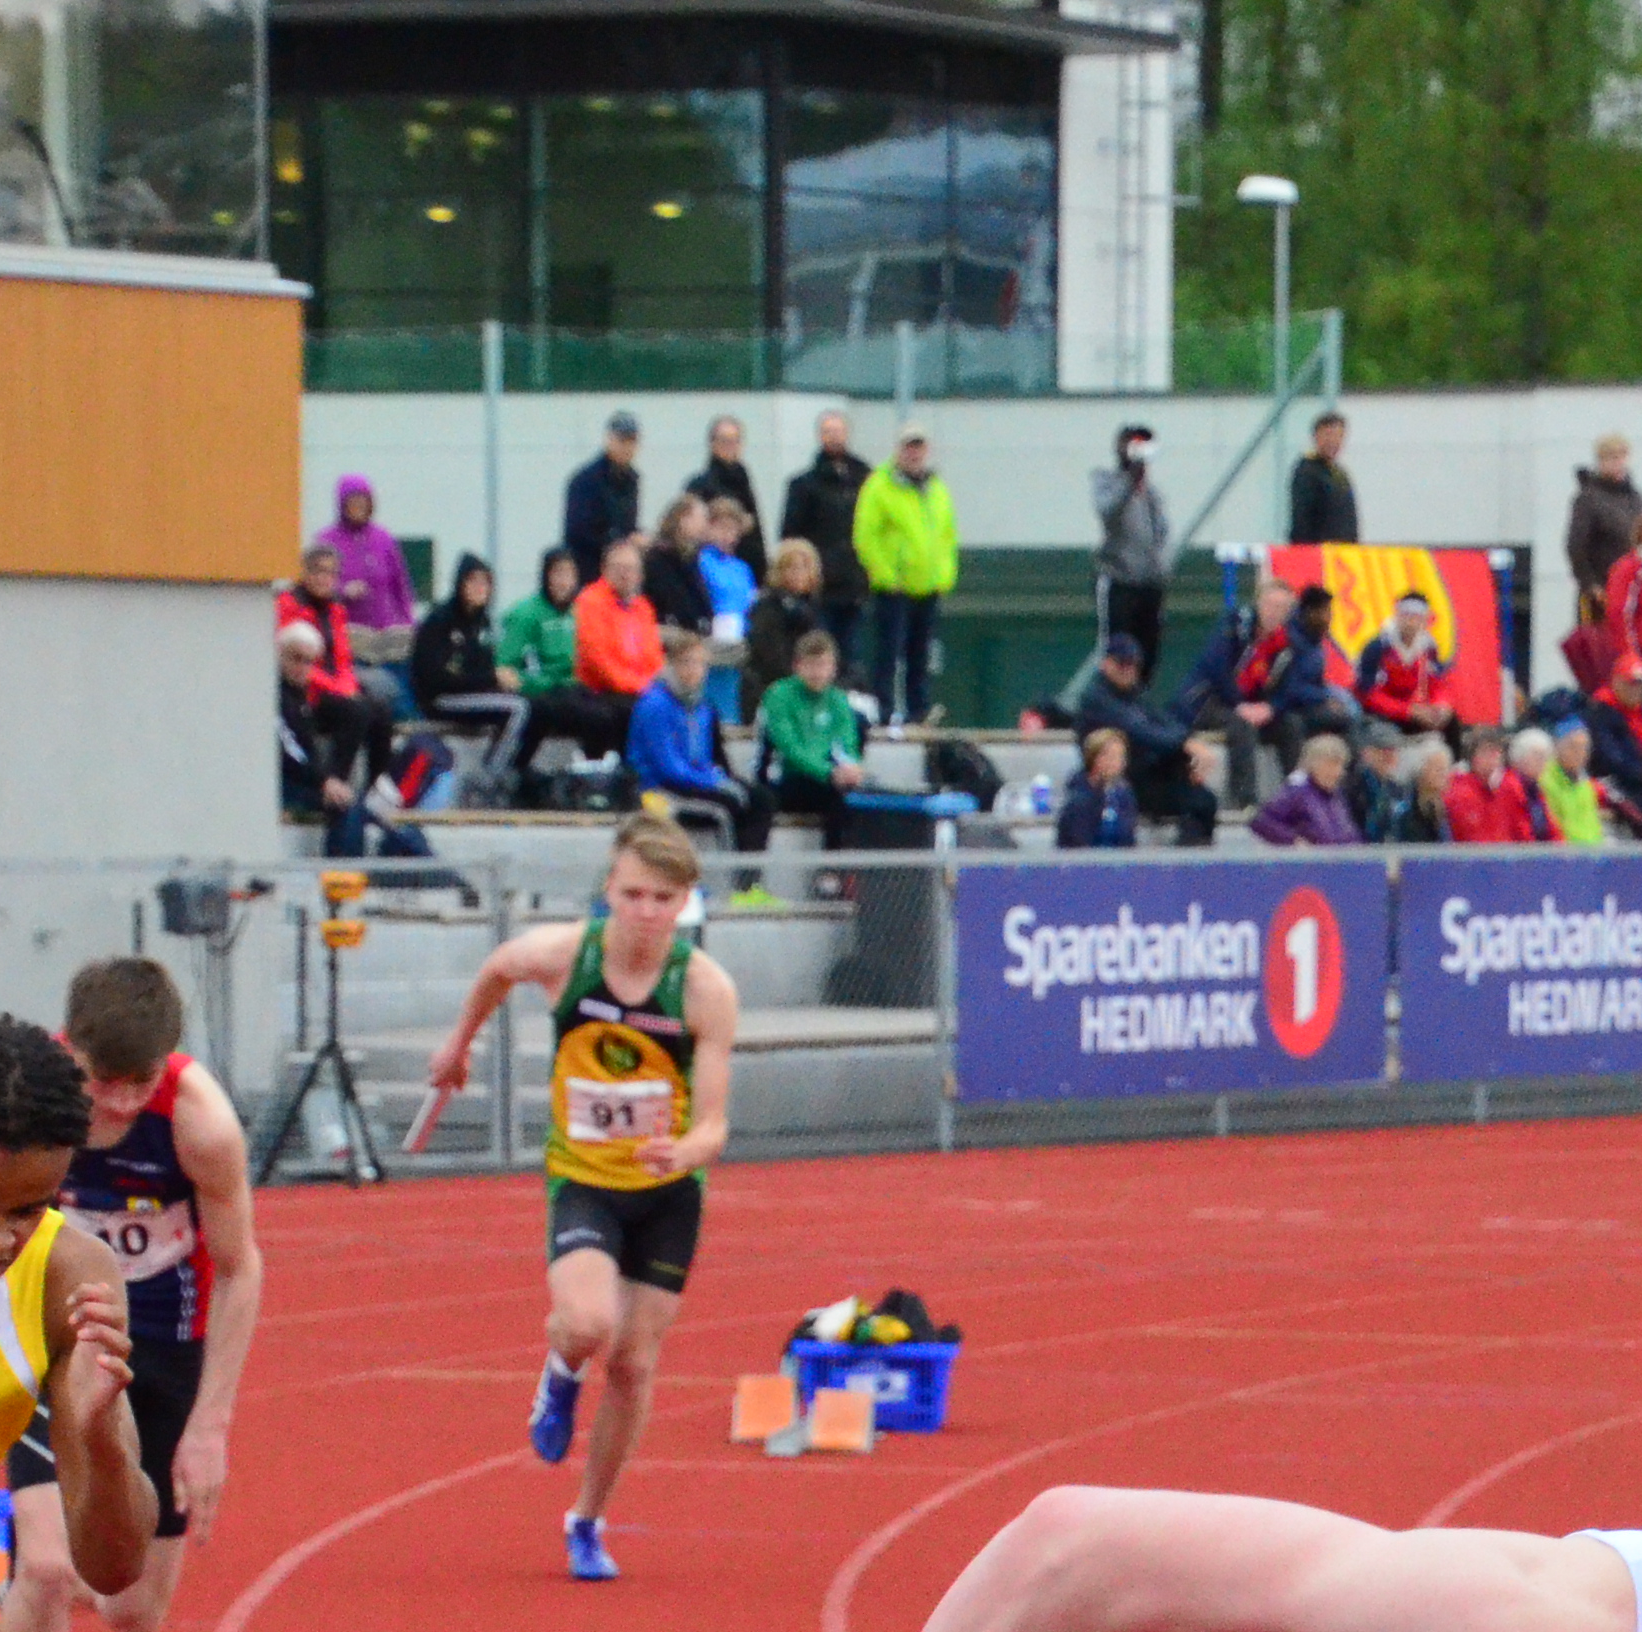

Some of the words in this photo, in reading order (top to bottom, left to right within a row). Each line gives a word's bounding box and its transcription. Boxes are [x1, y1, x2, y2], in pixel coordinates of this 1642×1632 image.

[1004, 903, 1260, 1000] Sparebanken
[1285, 917, 1318, 1025] 1
[1081, 991, 1258, 1054] HEDMARK
[590, 1101, 635, 1130] 91
